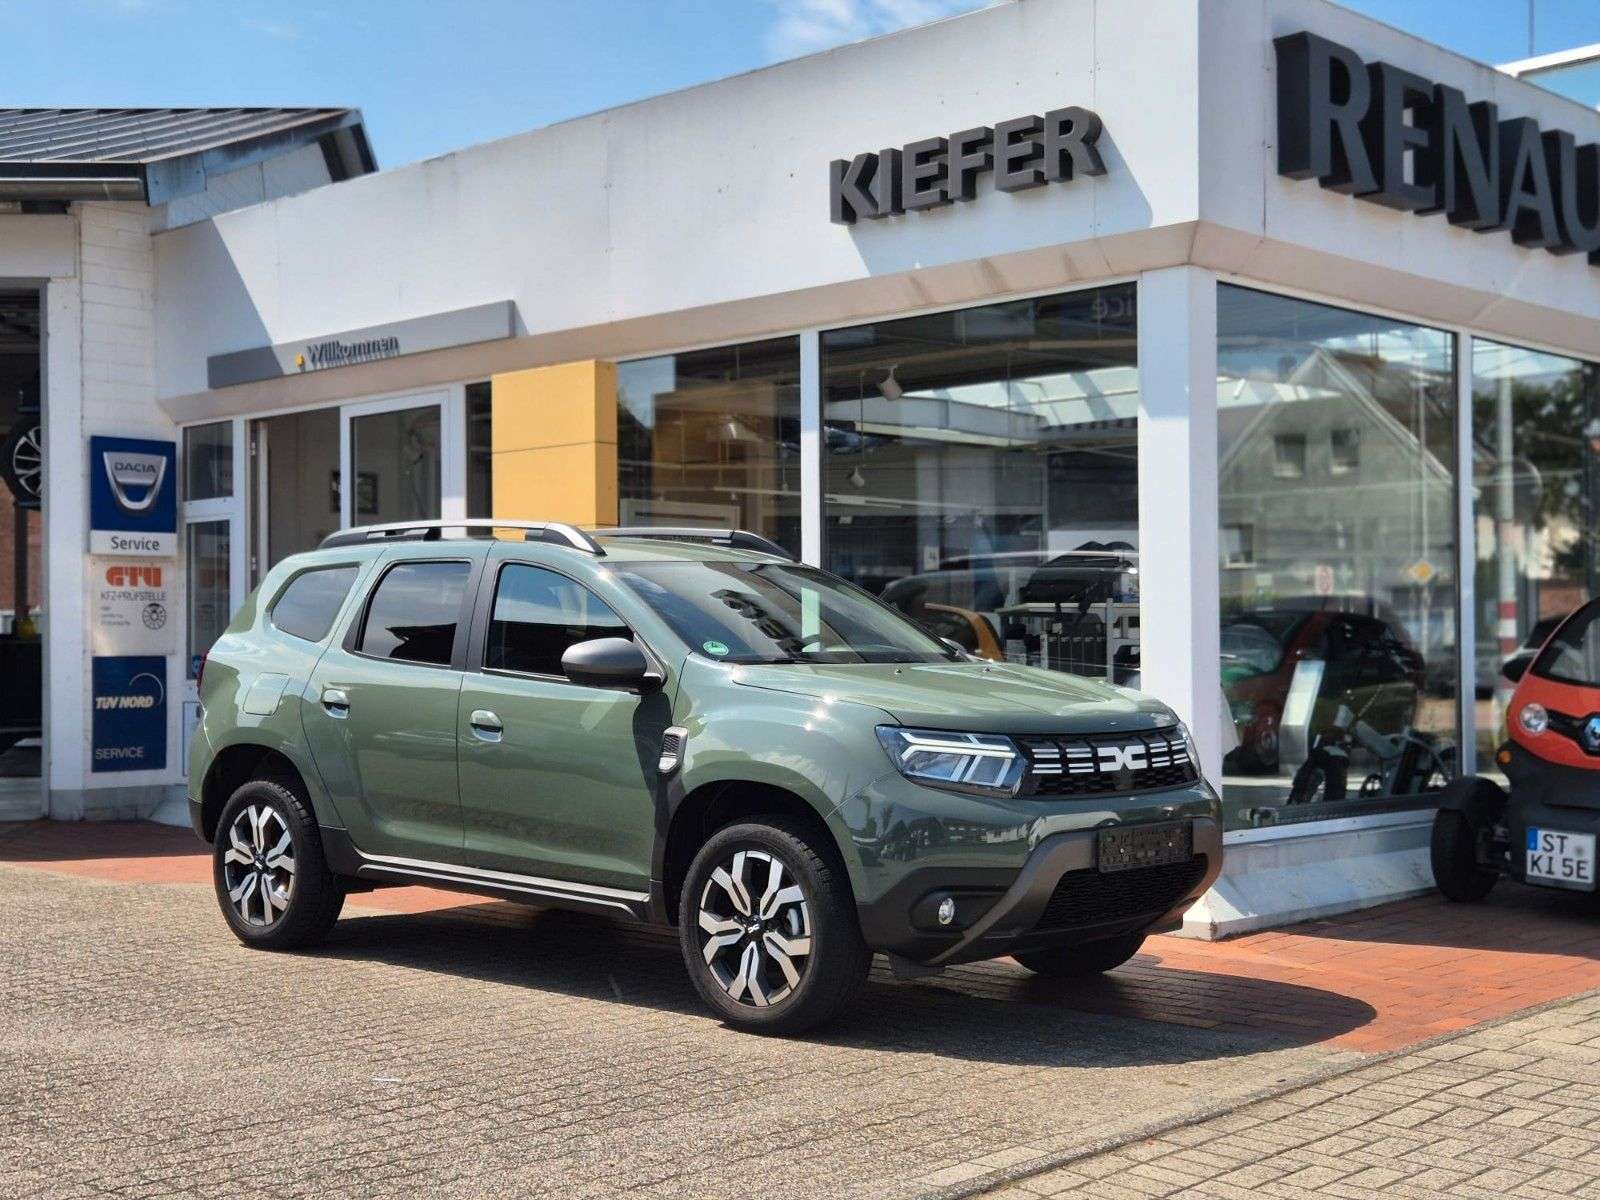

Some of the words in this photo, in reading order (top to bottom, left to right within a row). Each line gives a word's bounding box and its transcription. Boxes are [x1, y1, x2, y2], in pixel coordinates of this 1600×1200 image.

[1275, 31, 1600, 258] RENAU
[830, 106, 1107, 225] KIEFER
[307, 337, 398, 364] Willkommen
[114, 461, 156, 474] DACIA
[111, 536, 160, 551] Service
[118, 695, 154, 709] NORD
[95, 747, 144, 760] SERVICE
[1542, 834, 1568, 853] ST
